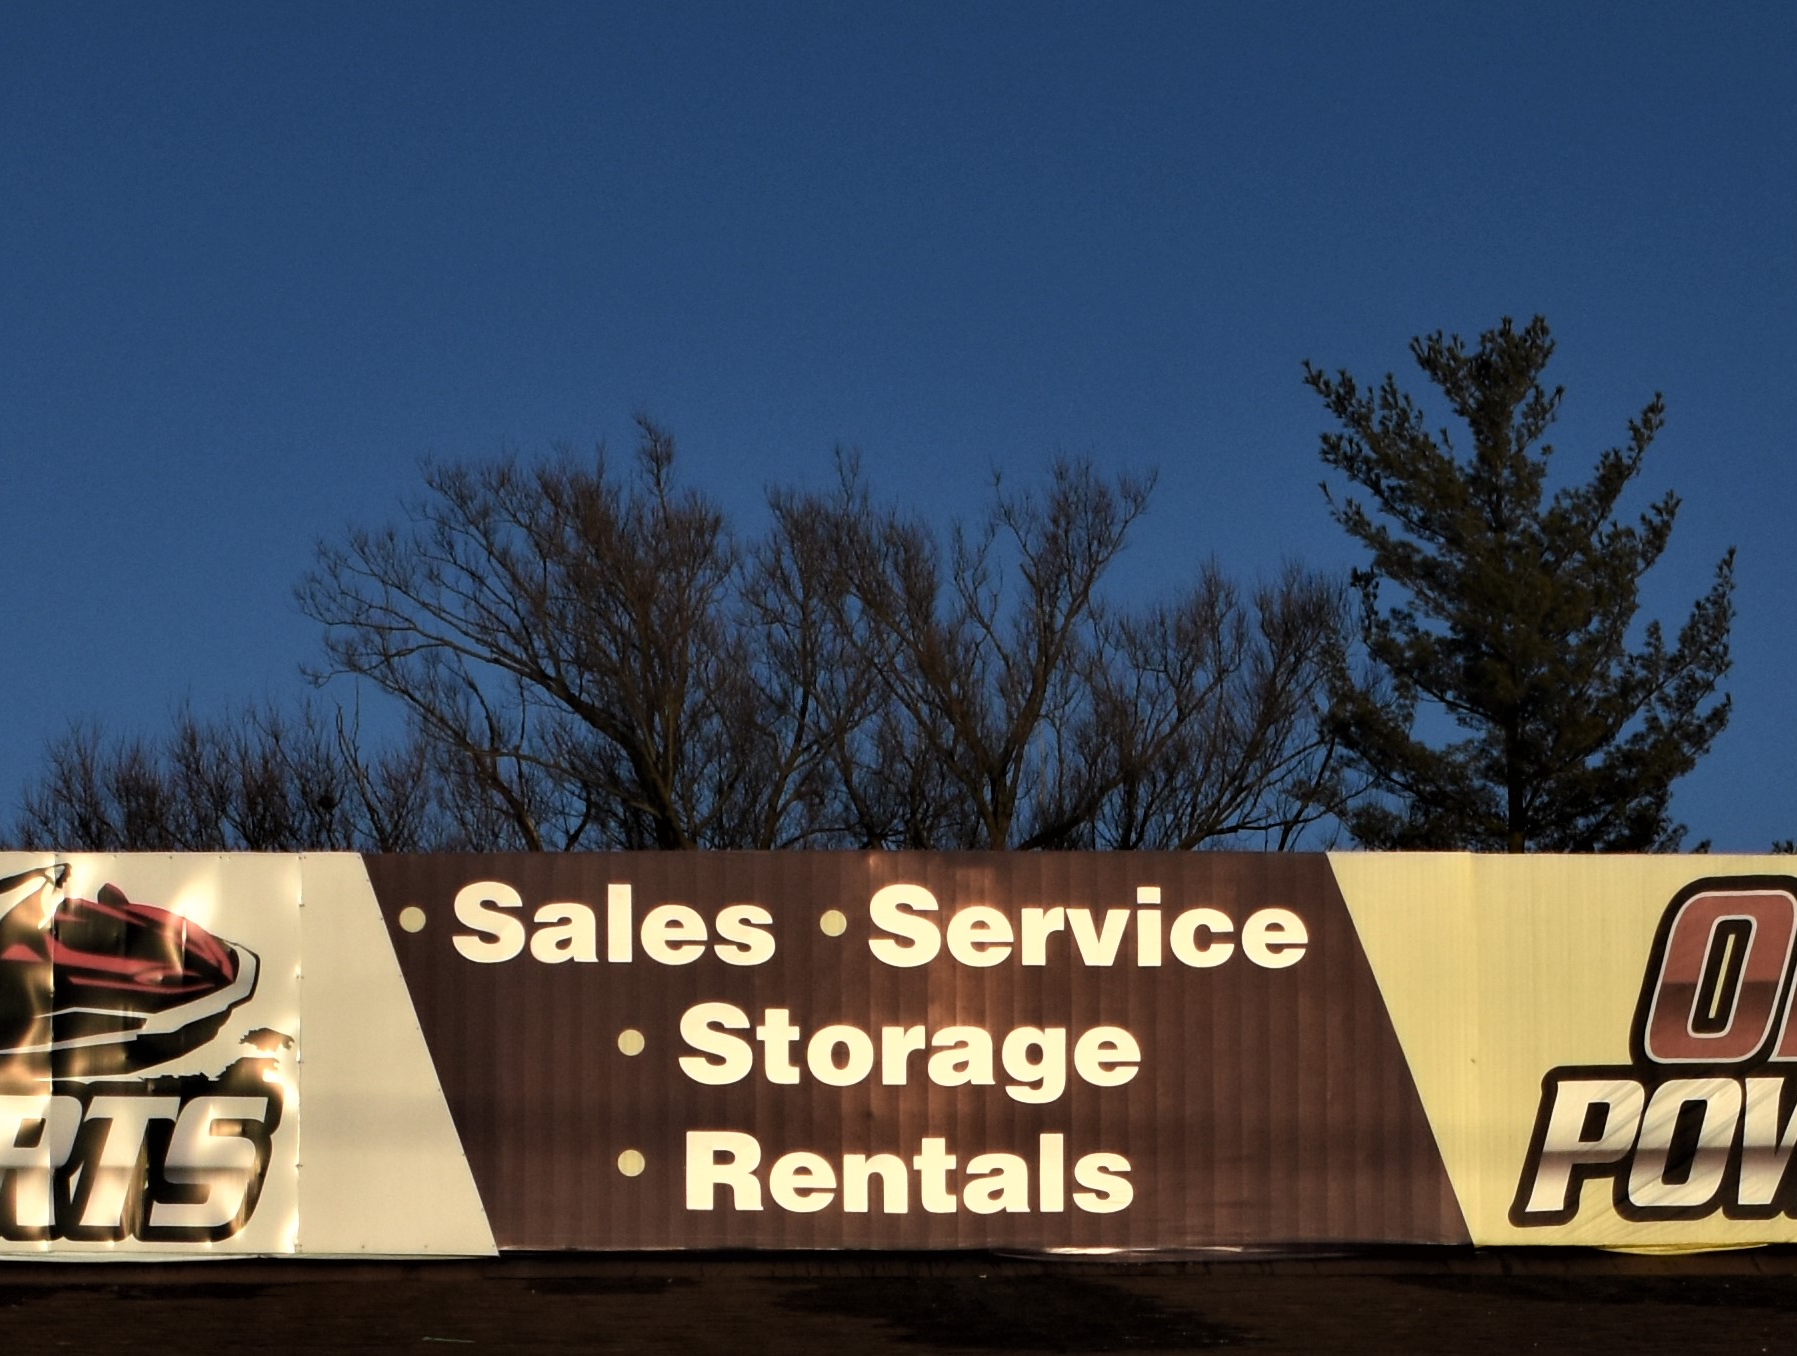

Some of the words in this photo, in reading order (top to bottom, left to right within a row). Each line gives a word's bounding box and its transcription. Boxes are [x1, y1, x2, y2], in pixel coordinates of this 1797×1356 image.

[453, 880, 775, 965] Sales
[868, 883, 1309, 968] Service
[678, 1002, 1141, 1103] Storage
[684, 1129, 1135, 1215] Rentals
